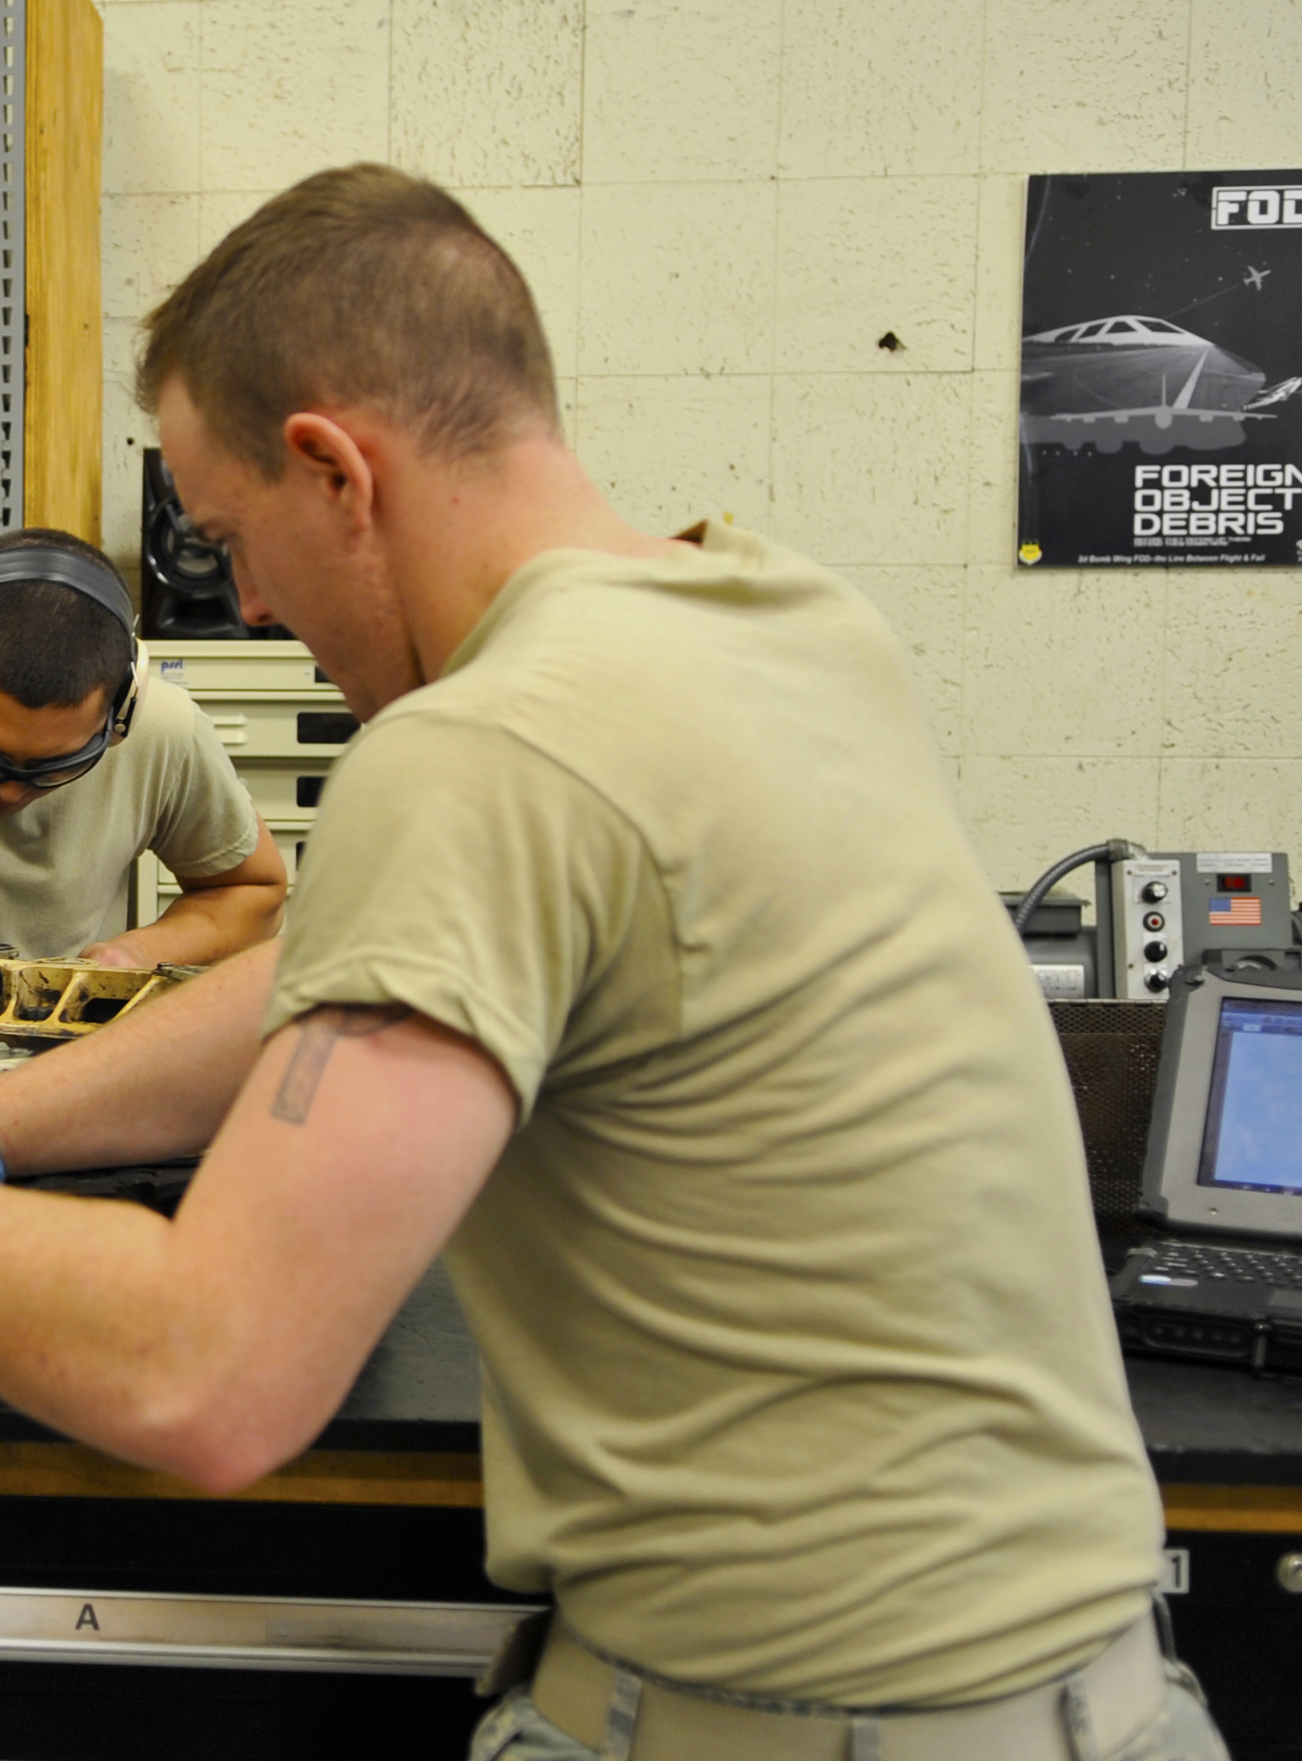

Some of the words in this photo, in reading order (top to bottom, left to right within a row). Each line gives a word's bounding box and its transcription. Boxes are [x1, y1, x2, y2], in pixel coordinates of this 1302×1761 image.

[1134, 464, 1302, 488] FOREIGN
[1134, 488, 1302, 511] OBJECT
[1133, 512, 1284, 536] DEBRIS
[1089, 554, 1111, 563] Bomb
[1113, 554, 1132, 565] Wing
[1168, 554, 1185, 563] Line
[1186, 554, 1218, 563] Between
[1220, 553, 1242, 564] Flight
[75, 1603, 100, 1631] A
